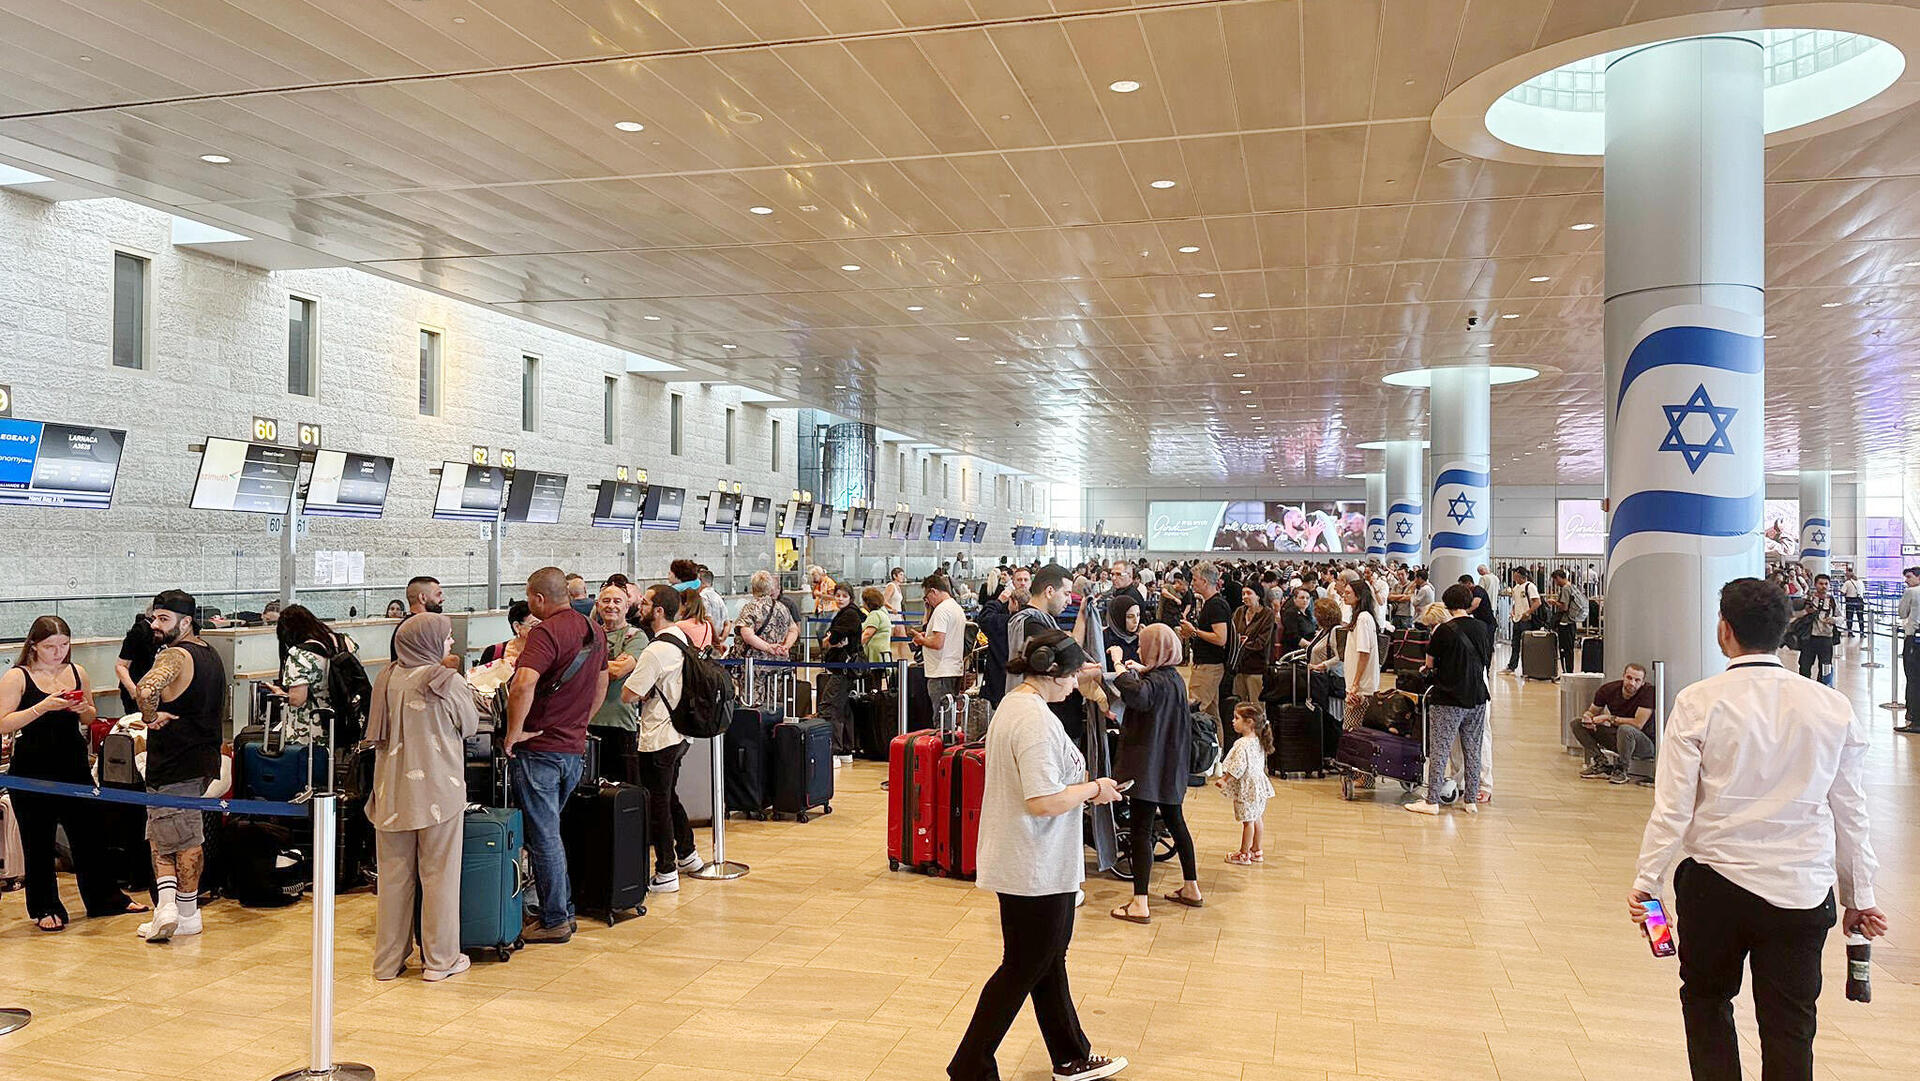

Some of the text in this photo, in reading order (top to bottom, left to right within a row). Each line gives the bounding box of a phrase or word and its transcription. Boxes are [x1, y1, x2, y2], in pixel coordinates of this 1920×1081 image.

[254, 419, 276, 441] 60
[300, 425, 320, 446] 61
[0, 434, 29, 442] EGEAN
[68, 434, 98, 443] LARNACA
[473, 447, 488, 465] 62
[501, 450, 516, 468] 63
[200, 472, 229, 481] azimuth
[270, 518, 281, 532] 60
[296, 519, 306, 533] 61
